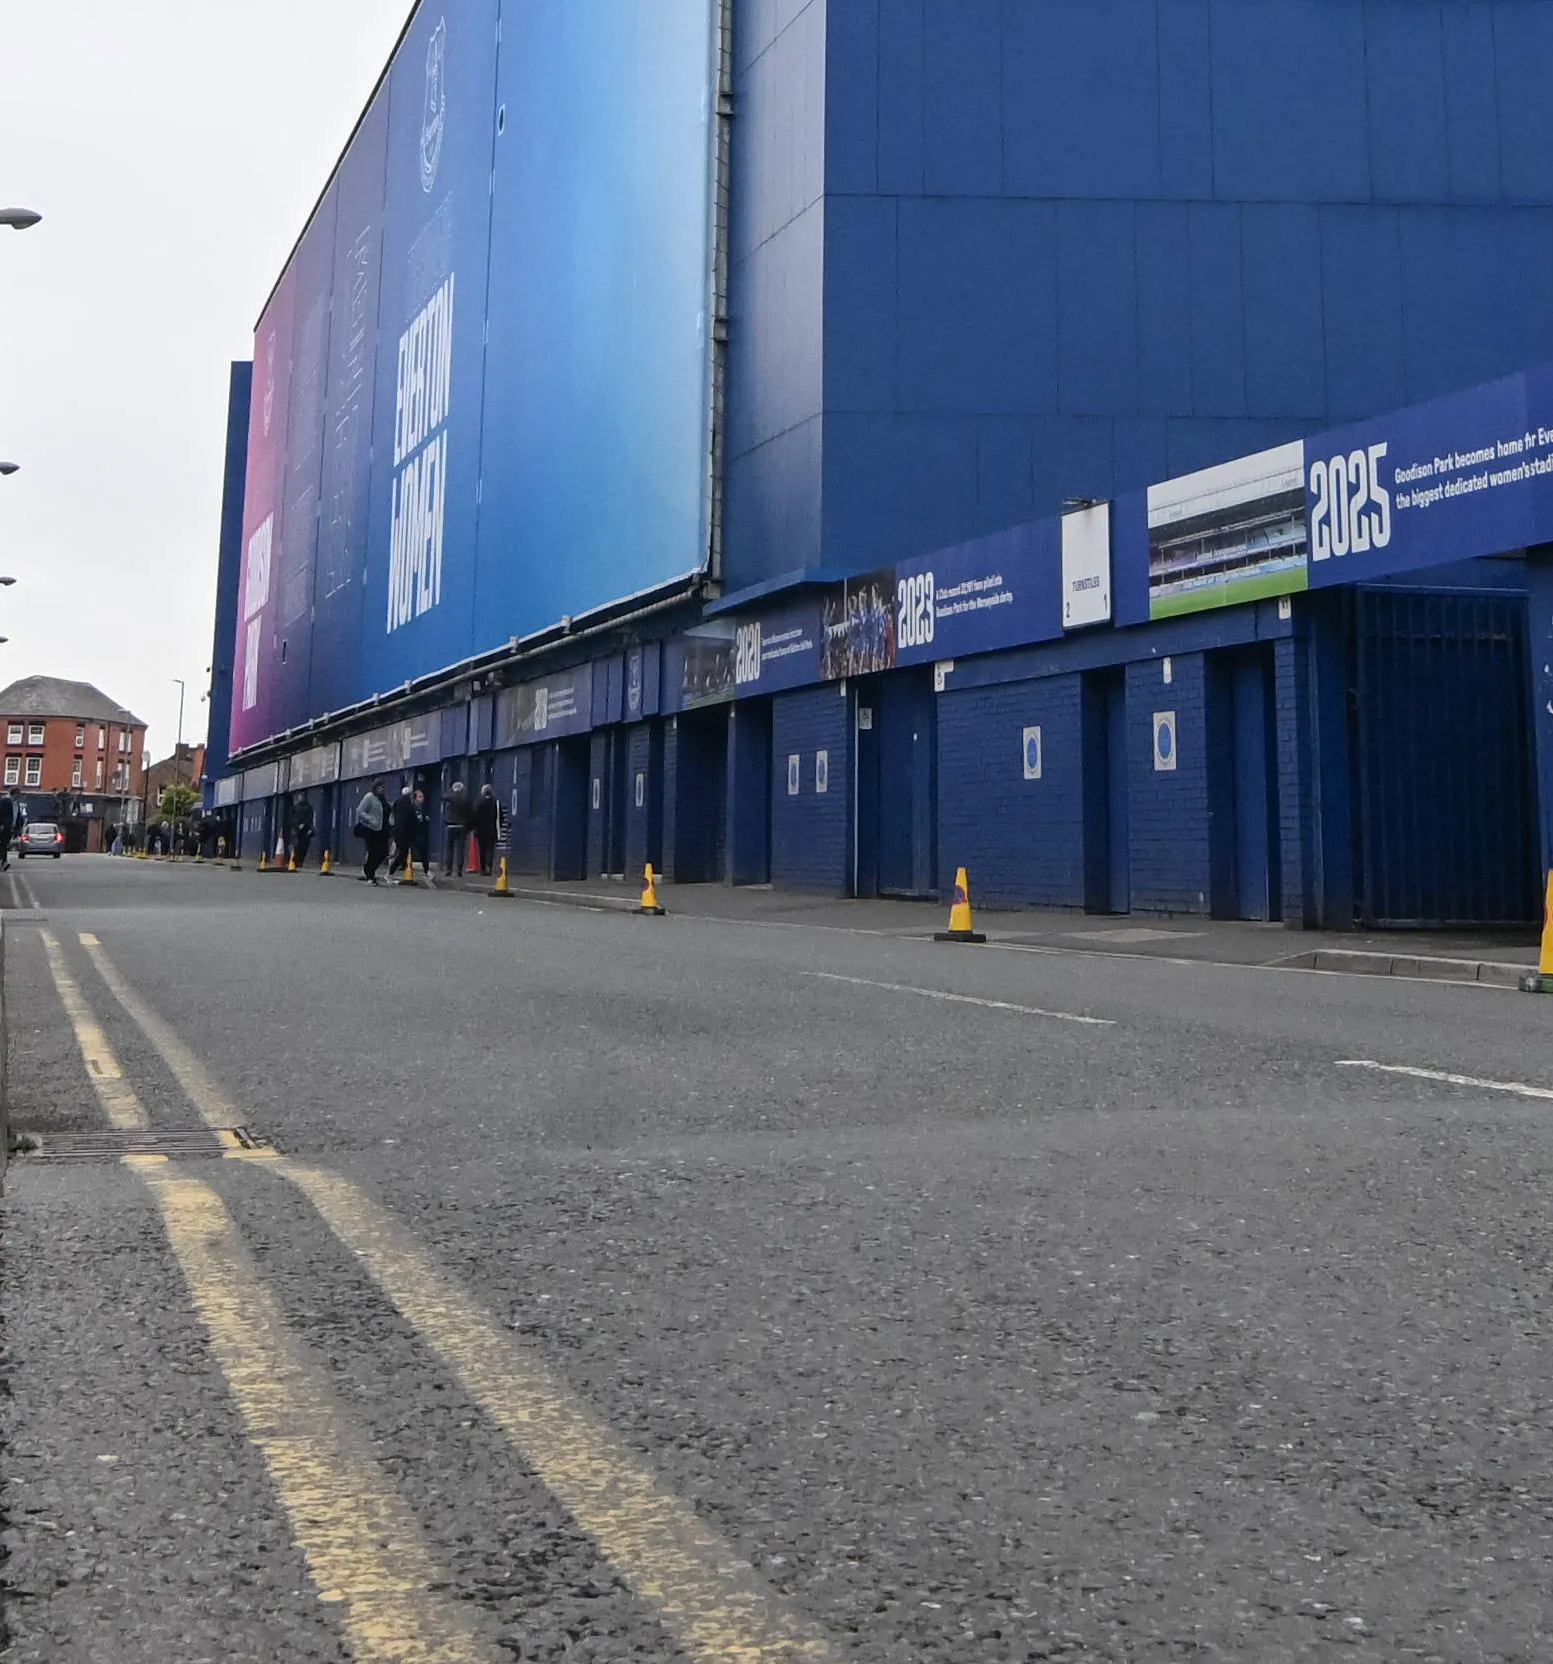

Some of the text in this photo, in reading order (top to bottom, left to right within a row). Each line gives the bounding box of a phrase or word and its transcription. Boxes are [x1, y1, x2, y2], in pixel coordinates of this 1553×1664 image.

[393, 271, 455, 468] EVERTON
[1395, 463, 1433, 485] Goodison
[1433, 456, 1454, 475] Park
[1454, 448, 1495, 469] becomes
[1496, 438, 1524, 458] home
[1396, 493, 1410, 510] the
[1411, 483, 1444, 508] biggest
[1444, 472, 1488, 498] dedicated
[1489, 463, 1529, 486] women's
[386, 429, 447, 635] WOMEN
[1310, 441, 1391, 562] 2025
[898, 571, 934, 648] 2023
[1066, 601, 1071, 618] 2
[736, 621, 761, 684] 2020
